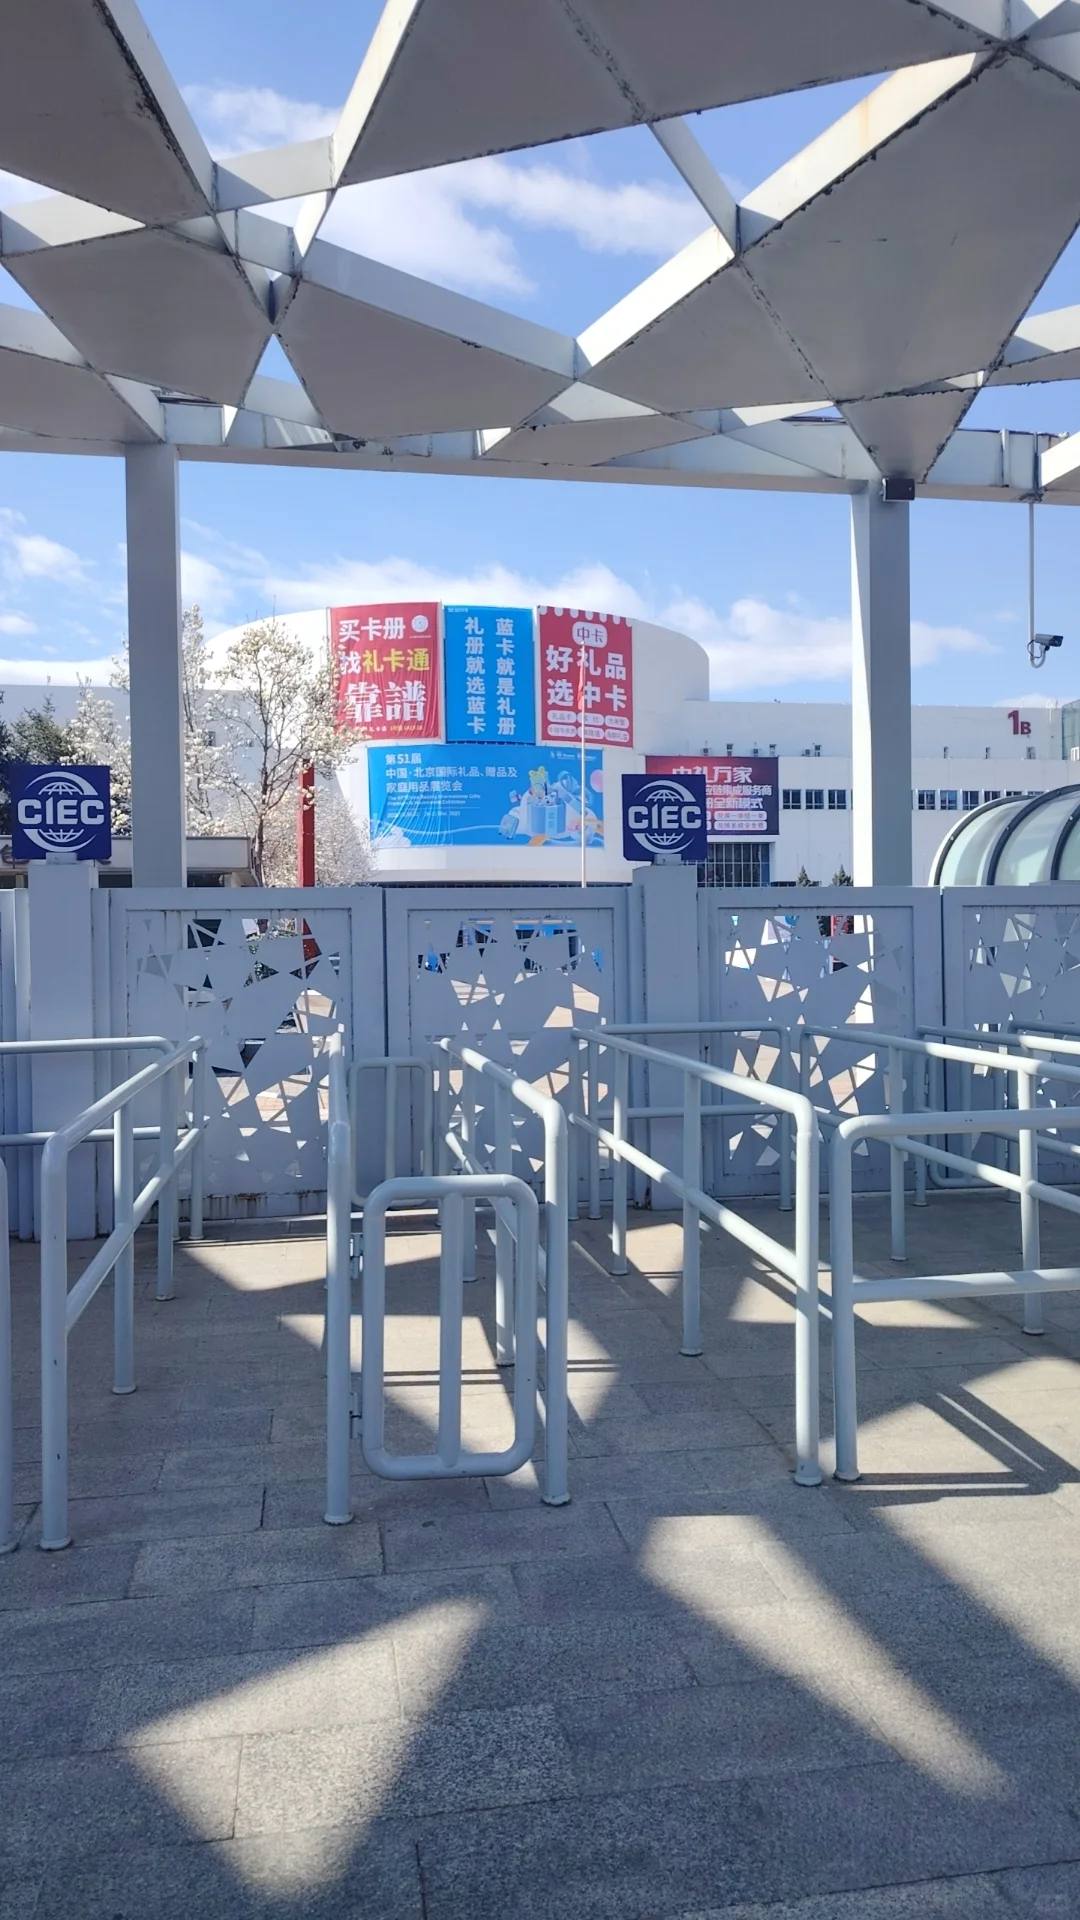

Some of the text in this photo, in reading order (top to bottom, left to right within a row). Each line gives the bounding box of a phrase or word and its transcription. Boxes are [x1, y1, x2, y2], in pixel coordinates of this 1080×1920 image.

[339, 617, 406, 641] 买卡册
[576, 626, 605, 644] 中卡
[340, 648, 431, 675] 找礼卡通
[546, 645, 627, 681] 好礼品
[464, 617, 486, 734] 礼册就选蓝卡
[495, 618, 516, 735] 蓝卡就是礼册
[547, 678, 627, 712] 选中卡
[385, 752, 422, 765] 第51届
[386, 780, 463, 793] 家庭用品展览会
[18, 797, 105, 825] CIEC
[628, 803, 701, 829] CIEC
